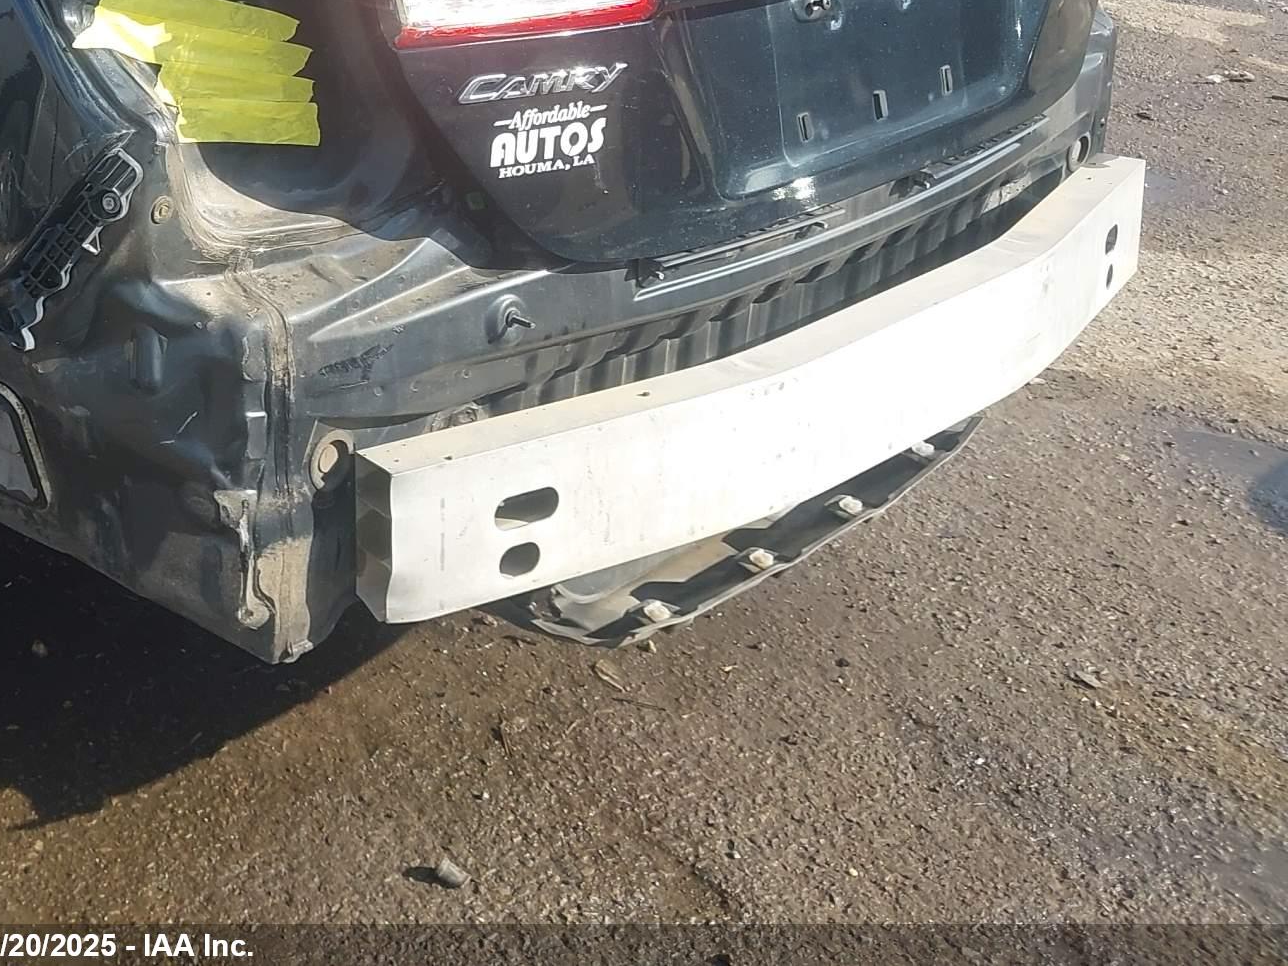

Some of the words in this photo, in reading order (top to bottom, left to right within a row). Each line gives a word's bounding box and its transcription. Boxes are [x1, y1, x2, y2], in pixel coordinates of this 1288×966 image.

[458, 62, 628, 104] CAMRY
[508, 100, 591, 131] Affordable
[490, 117, 607, 168] AUTOS
[498, 158, 571, 179] HOUMA,
[572, 153, 595, 167] LA
